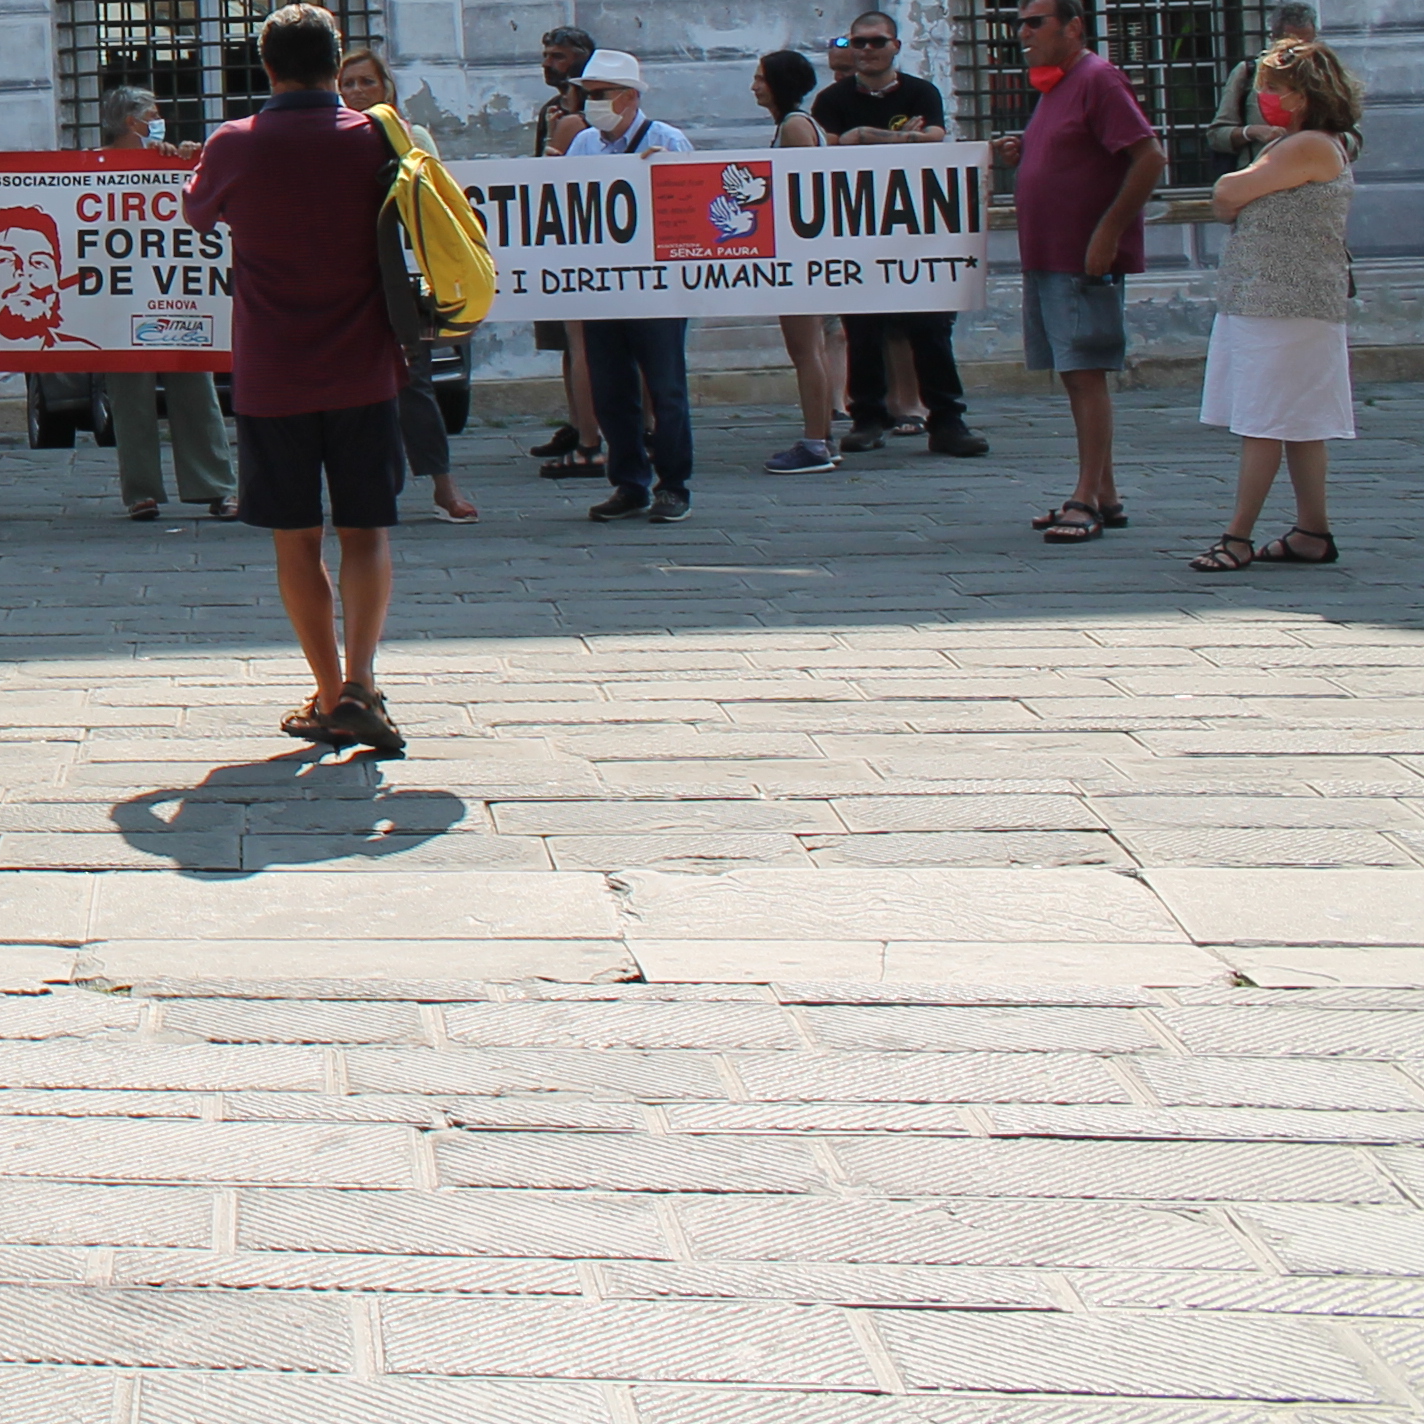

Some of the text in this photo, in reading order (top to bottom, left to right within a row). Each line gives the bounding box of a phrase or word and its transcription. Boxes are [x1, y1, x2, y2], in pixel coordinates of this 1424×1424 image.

[97, 173, 180, 186] NAZIONALE
[787, 166, 980, 239] UMANI
[77, 228, 232, 259] FORES
[670, 247, 758, 257] SENZA PAURA
[78, 266, 133, 296] DE
[542, 265, 668, 294] DIRITTI
[682, 260, 793, 290] UMANI
[808, 257, 863, 287] PER
[148, 300, 197, 310] GENOVA
[169, 320, 203, 331] ITALIA
